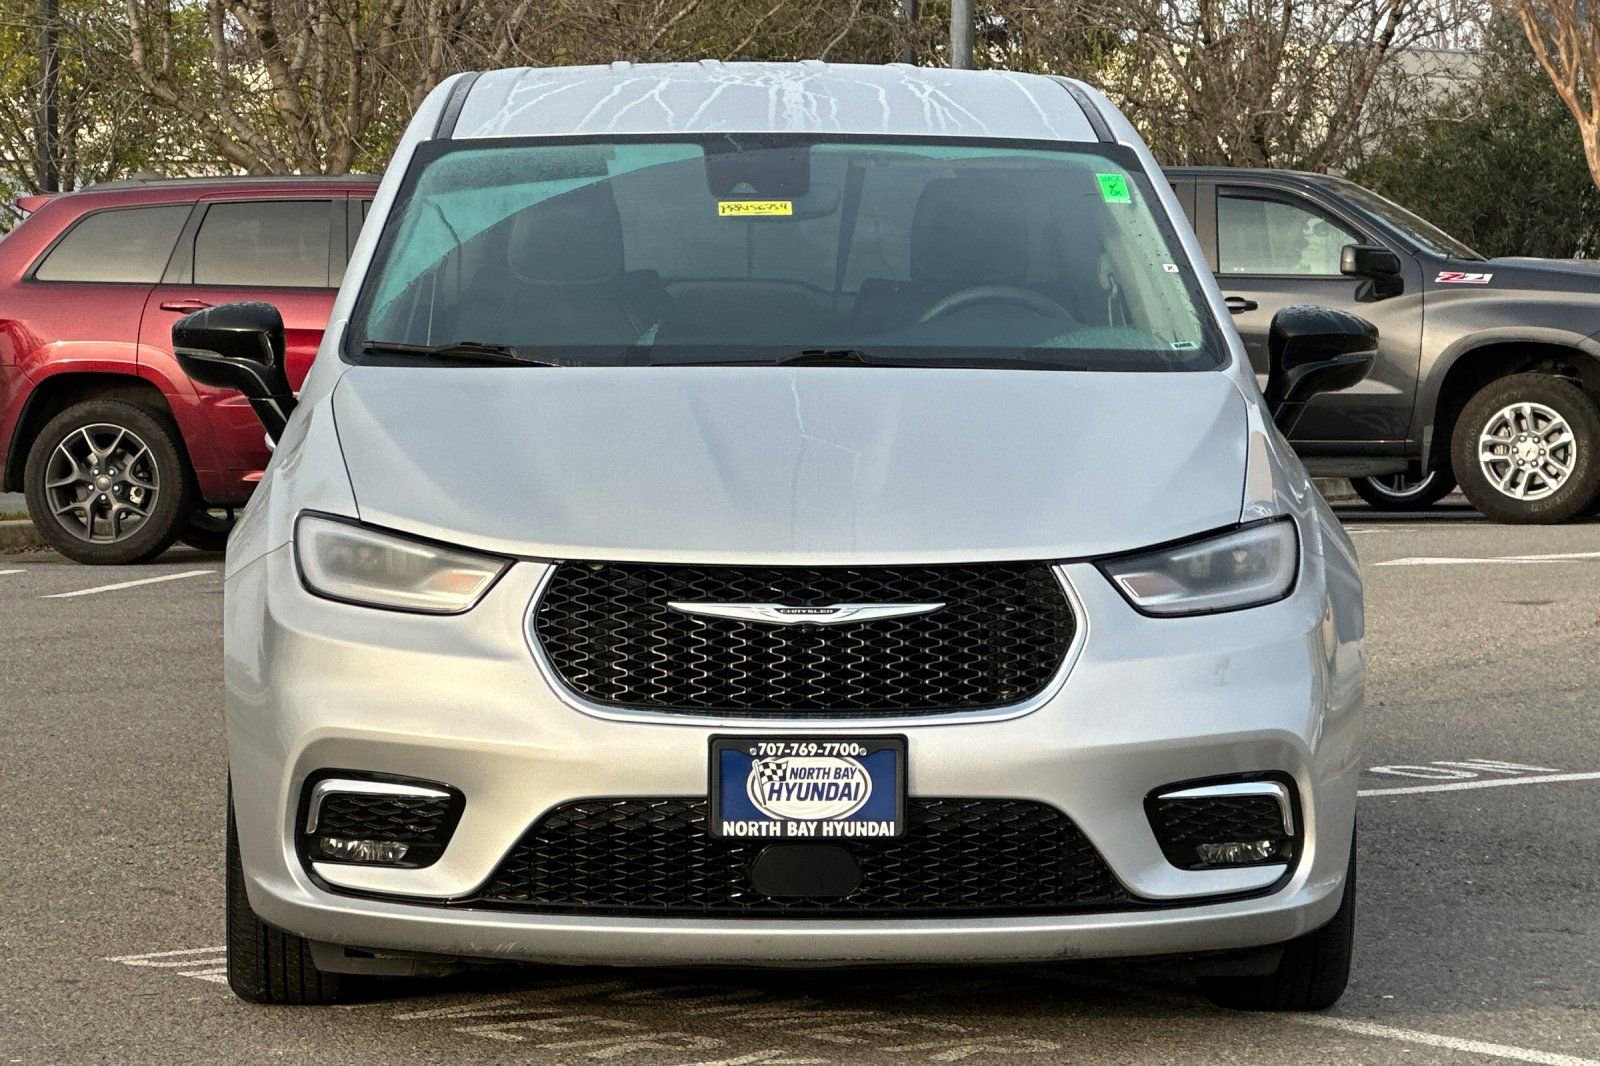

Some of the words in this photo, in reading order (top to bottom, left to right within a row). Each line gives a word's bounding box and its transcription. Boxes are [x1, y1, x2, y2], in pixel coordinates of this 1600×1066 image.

[1435, 271, 1494, 284] Z71
[757, 742, 859, 757] 707-769-7700
[789, 767, 832, 780] NORTH
[833, 767, 858, 779] BAY
[767, 782, 861, 802] HYUNDAI
[722, 821, 781, 837] NORTH
[787, 821, 819, 837] BAY
[822, 821, 895, 837] HYUNDAI
